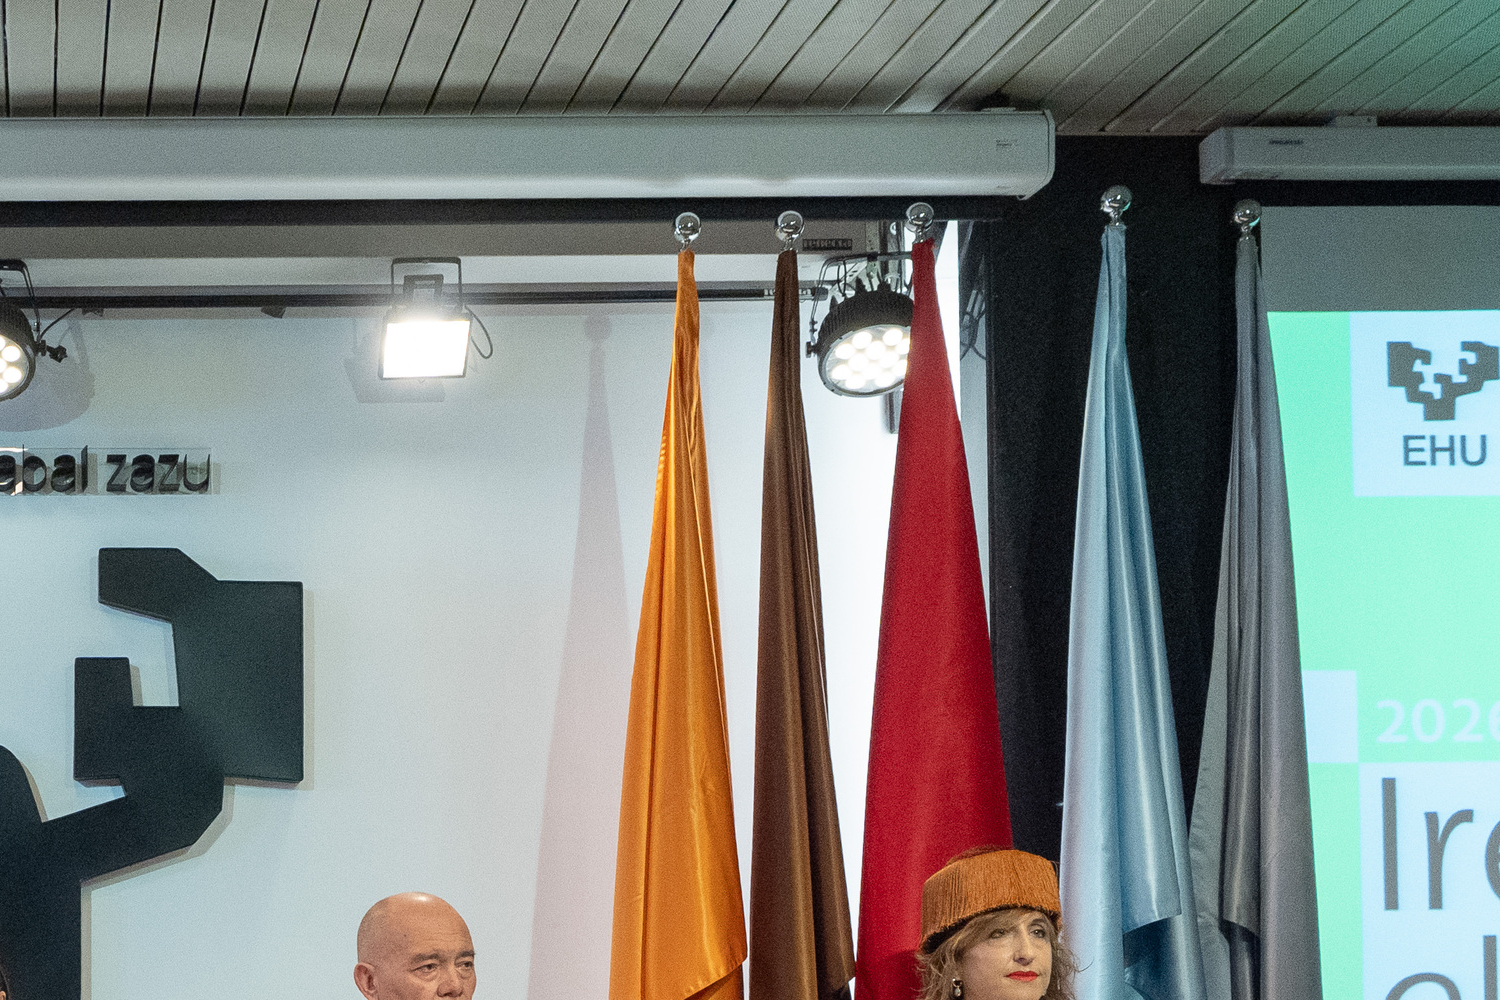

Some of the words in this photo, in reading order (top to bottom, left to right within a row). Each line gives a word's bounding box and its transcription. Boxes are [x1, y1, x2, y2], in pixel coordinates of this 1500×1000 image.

[1402, 434, 1487, 466] EHU
[106, 453, 211, 492] zazu
[1381, 777, 1500, 911] Ir
